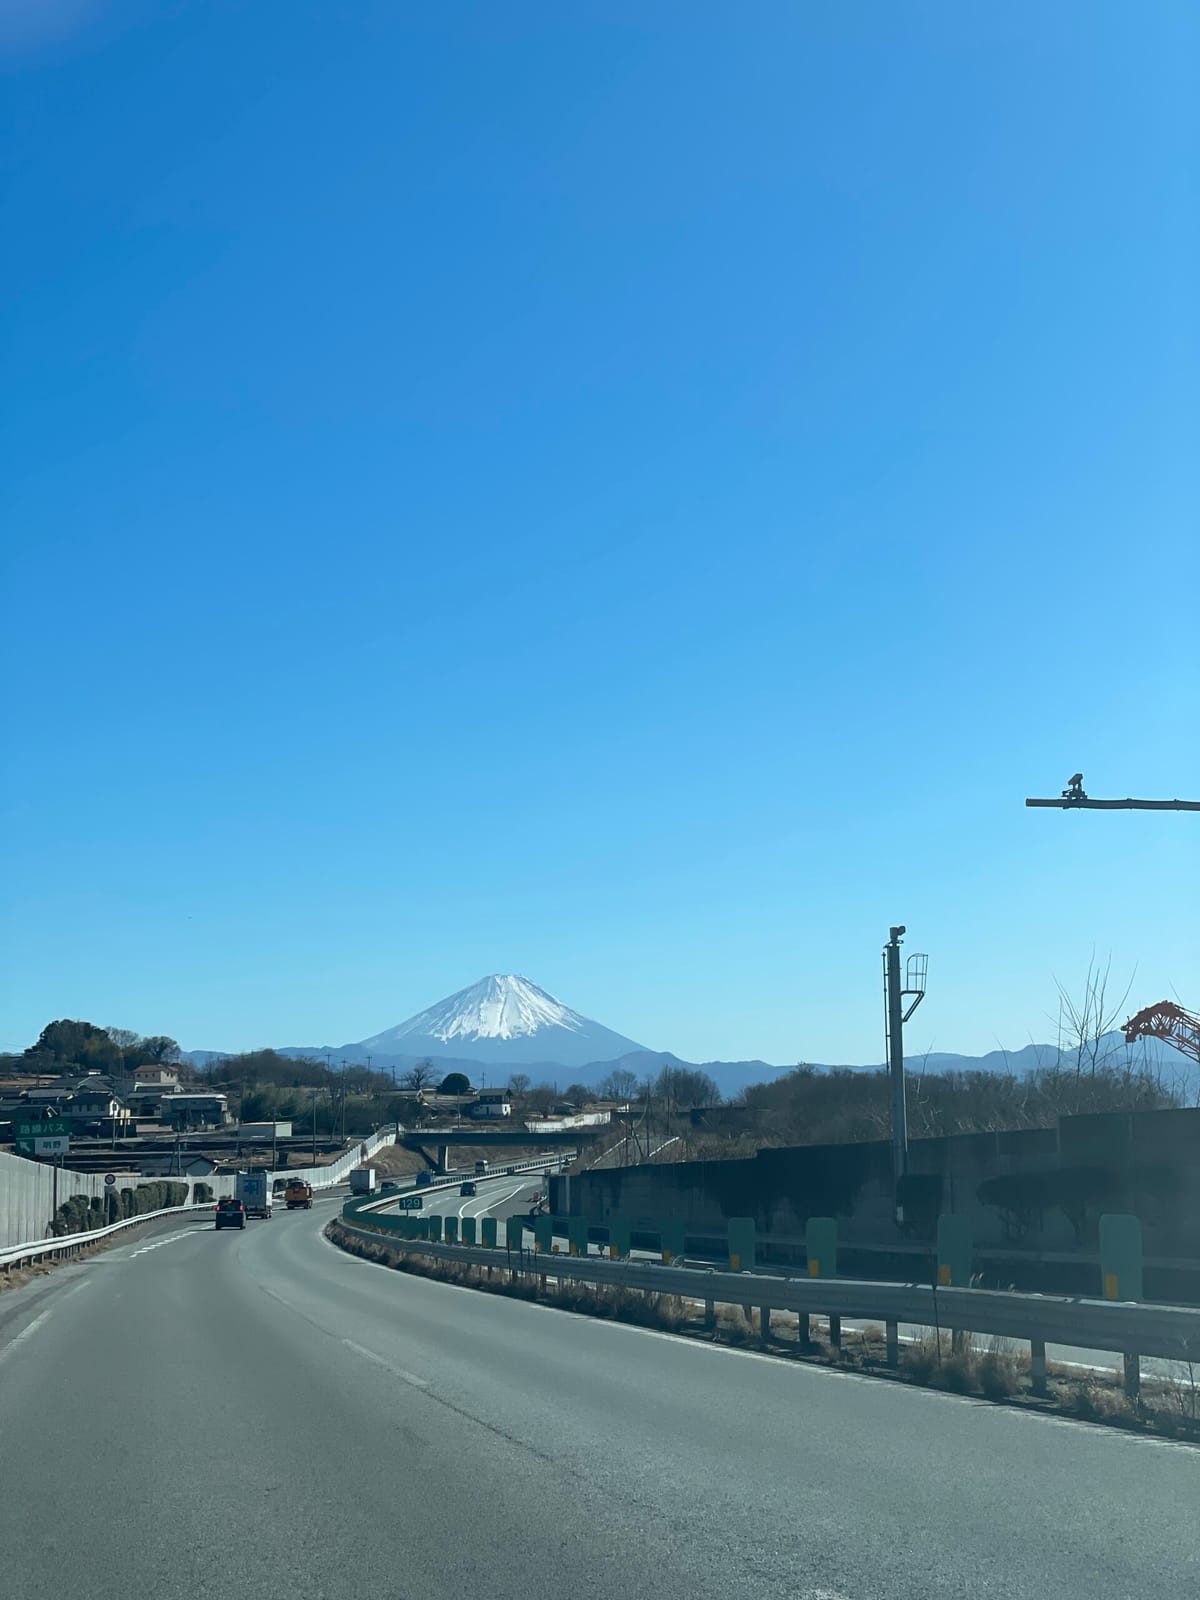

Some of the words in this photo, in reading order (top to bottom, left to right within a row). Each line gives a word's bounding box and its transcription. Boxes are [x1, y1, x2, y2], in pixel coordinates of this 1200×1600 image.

[20, 1123, 65, 1134] 路線バス
[402, 1199, 420, 1208] 129
